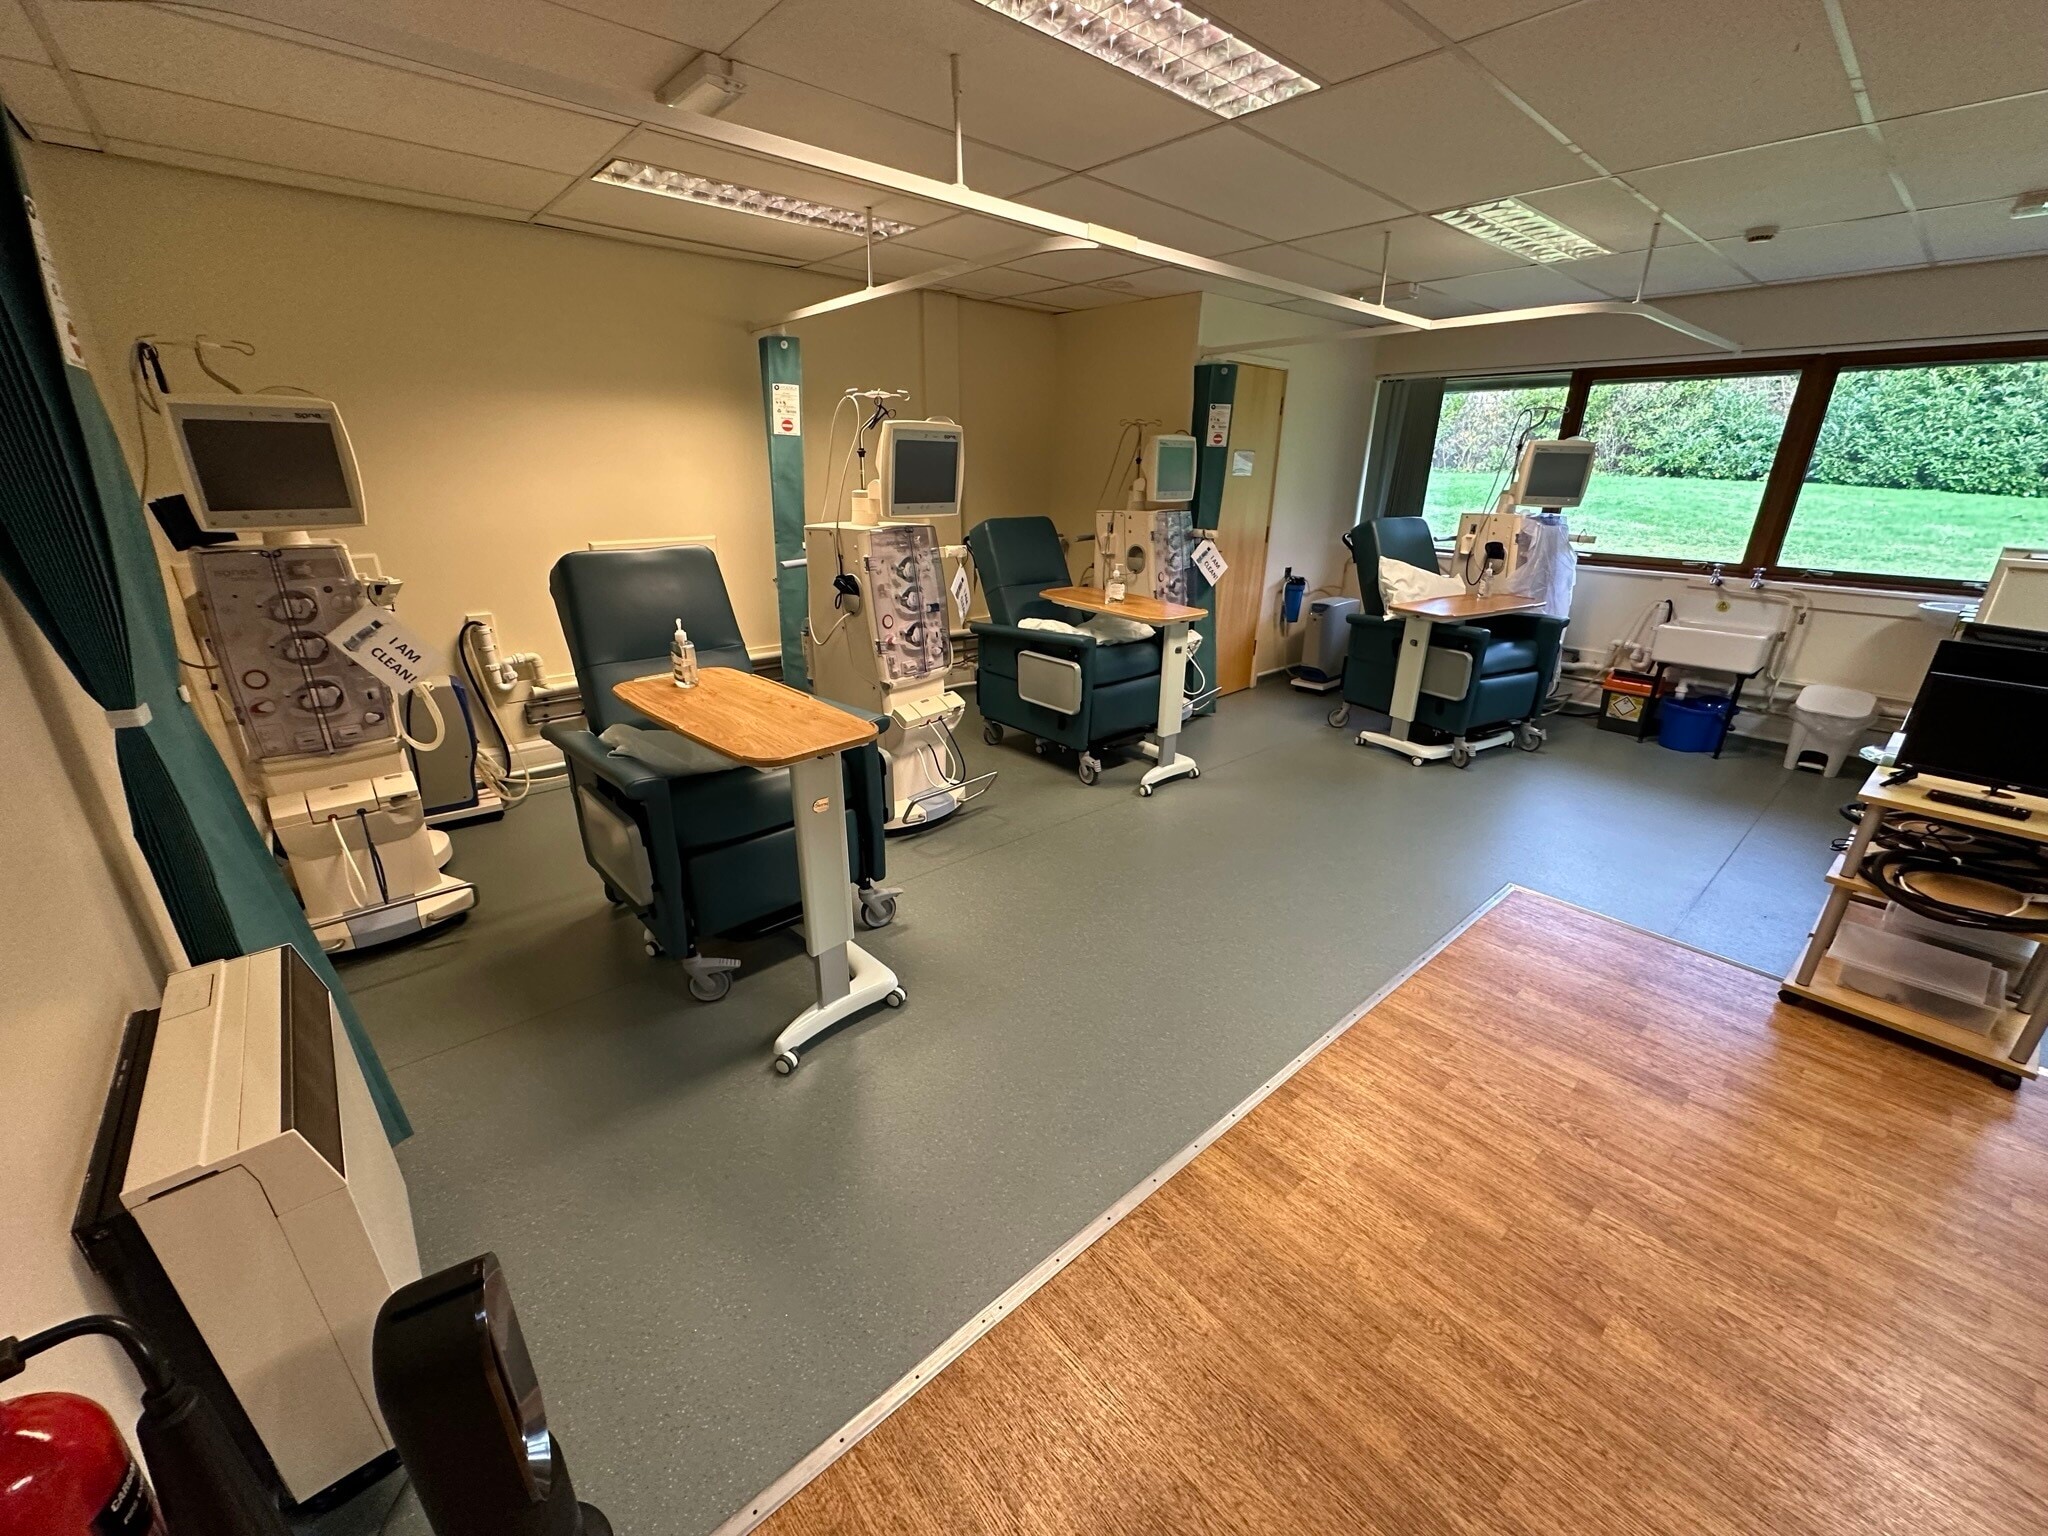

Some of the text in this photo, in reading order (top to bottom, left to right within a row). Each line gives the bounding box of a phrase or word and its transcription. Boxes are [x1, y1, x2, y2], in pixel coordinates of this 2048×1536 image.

[1211, 559, 1221, 569] AM
[388, 637, 422, 664] I AM
[371, 647, 418, 684] CLEAN!
